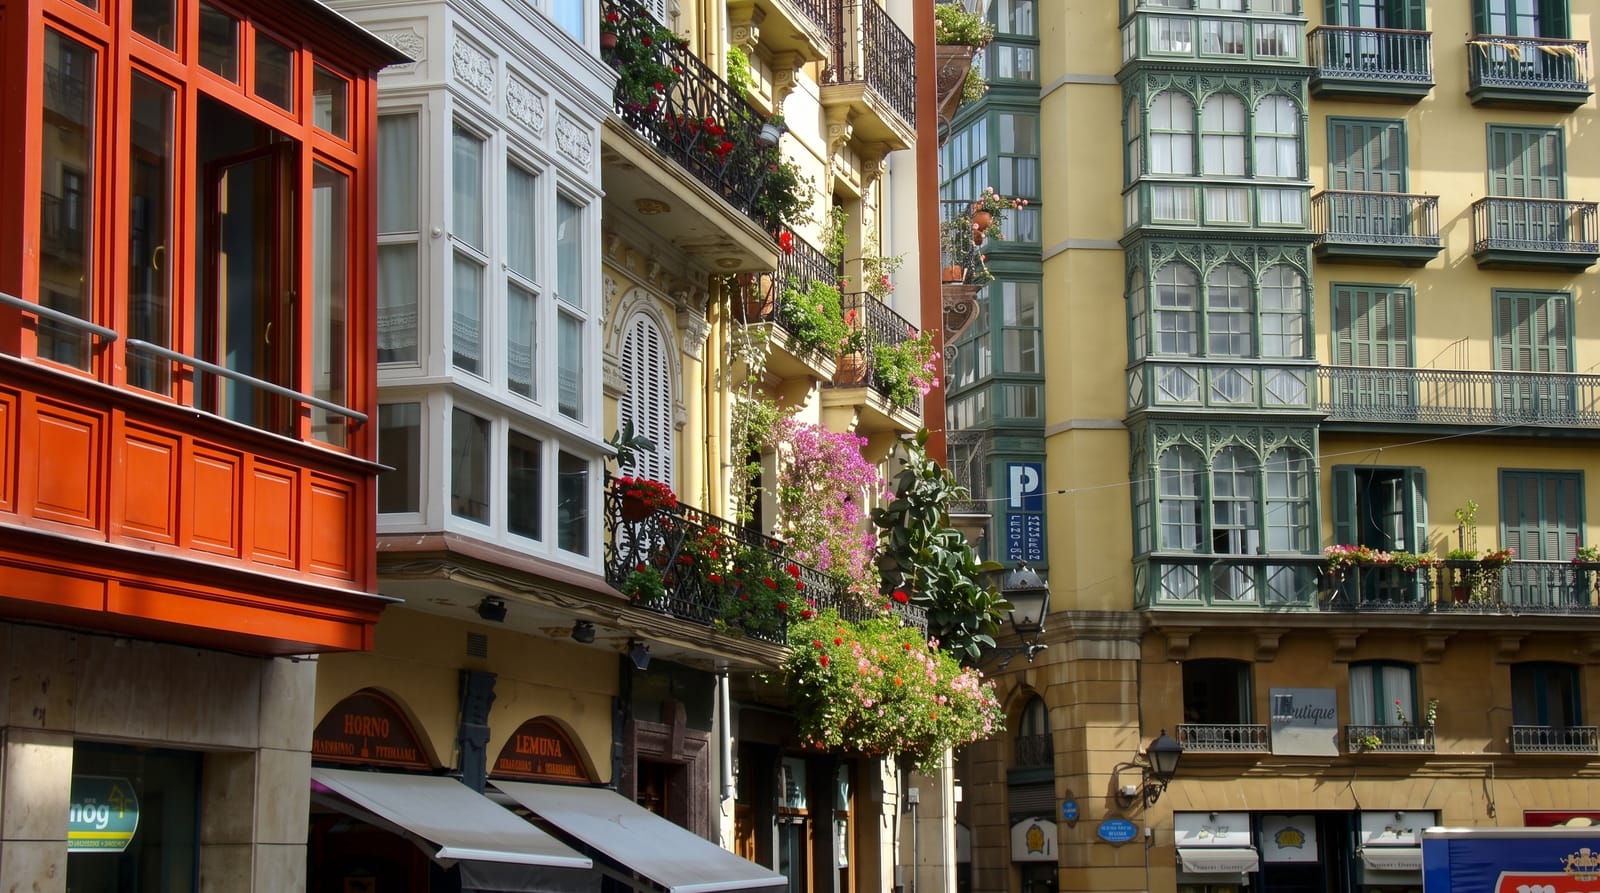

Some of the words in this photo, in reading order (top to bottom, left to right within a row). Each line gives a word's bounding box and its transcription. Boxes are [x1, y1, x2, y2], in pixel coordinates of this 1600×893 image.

[1010, 466, 1038, 507] P
[344, 714, 390, 738] HORNO
[516, 735, 562, 757] LEMUNA
